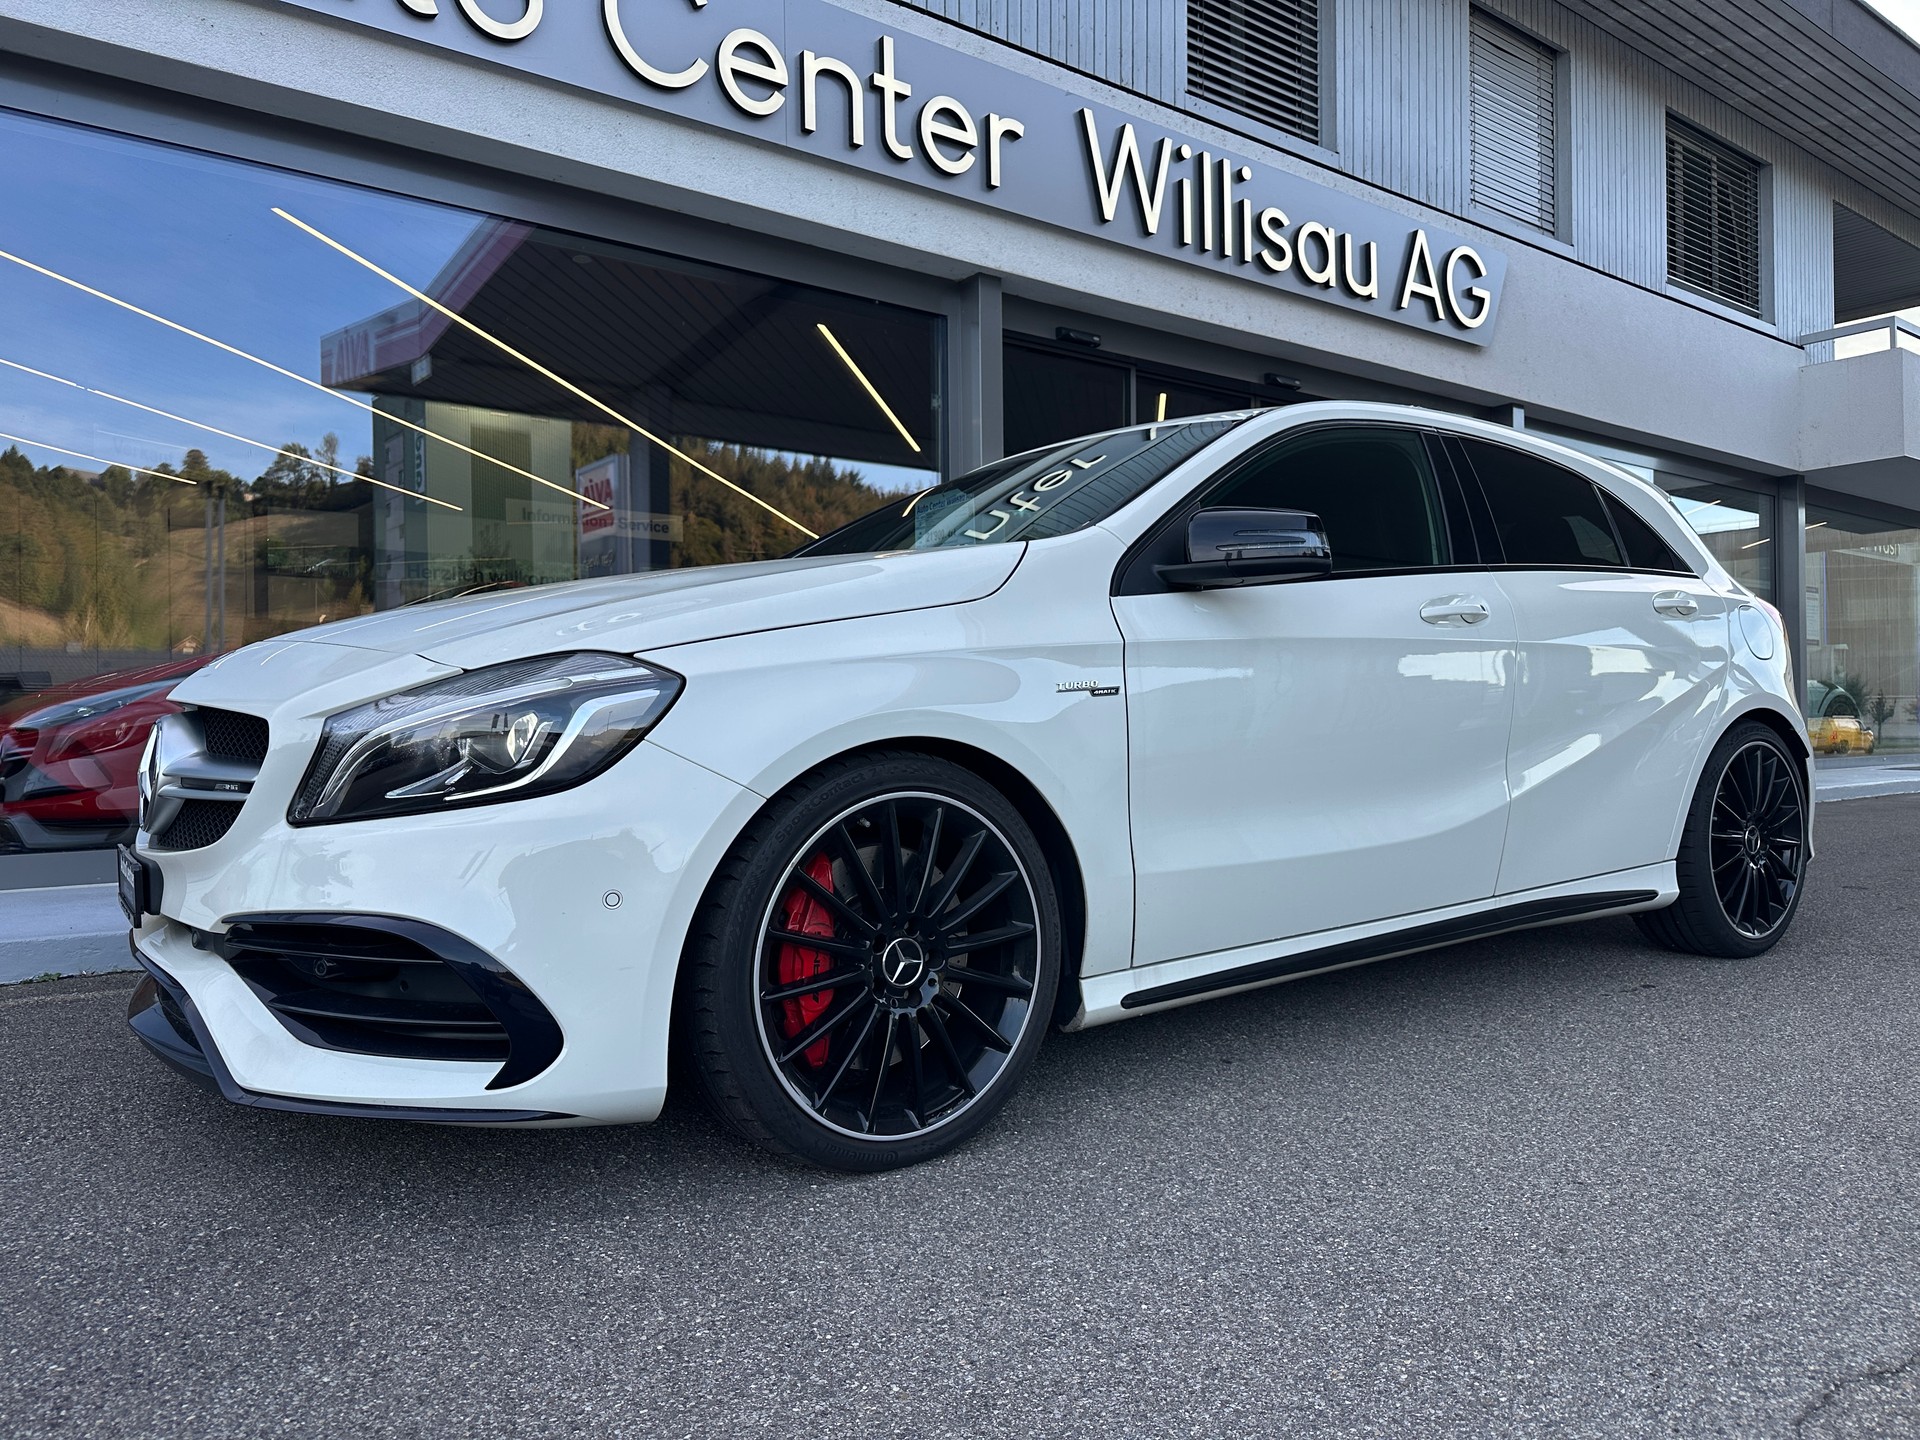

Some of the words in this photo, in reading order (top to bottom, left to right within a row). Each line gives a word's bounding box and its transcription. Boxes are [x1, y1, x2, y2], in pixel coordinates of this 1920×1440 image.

[600, 0, 1025, 190] Center
[1078, 107, 1379, 300] Willisau
[1398, 229, 1492, 330] AG
[618, 517, 670, 534] Service
[407, 563, 485, 583] Herzlich
[1056, 680, 1099, 691] TURBO
